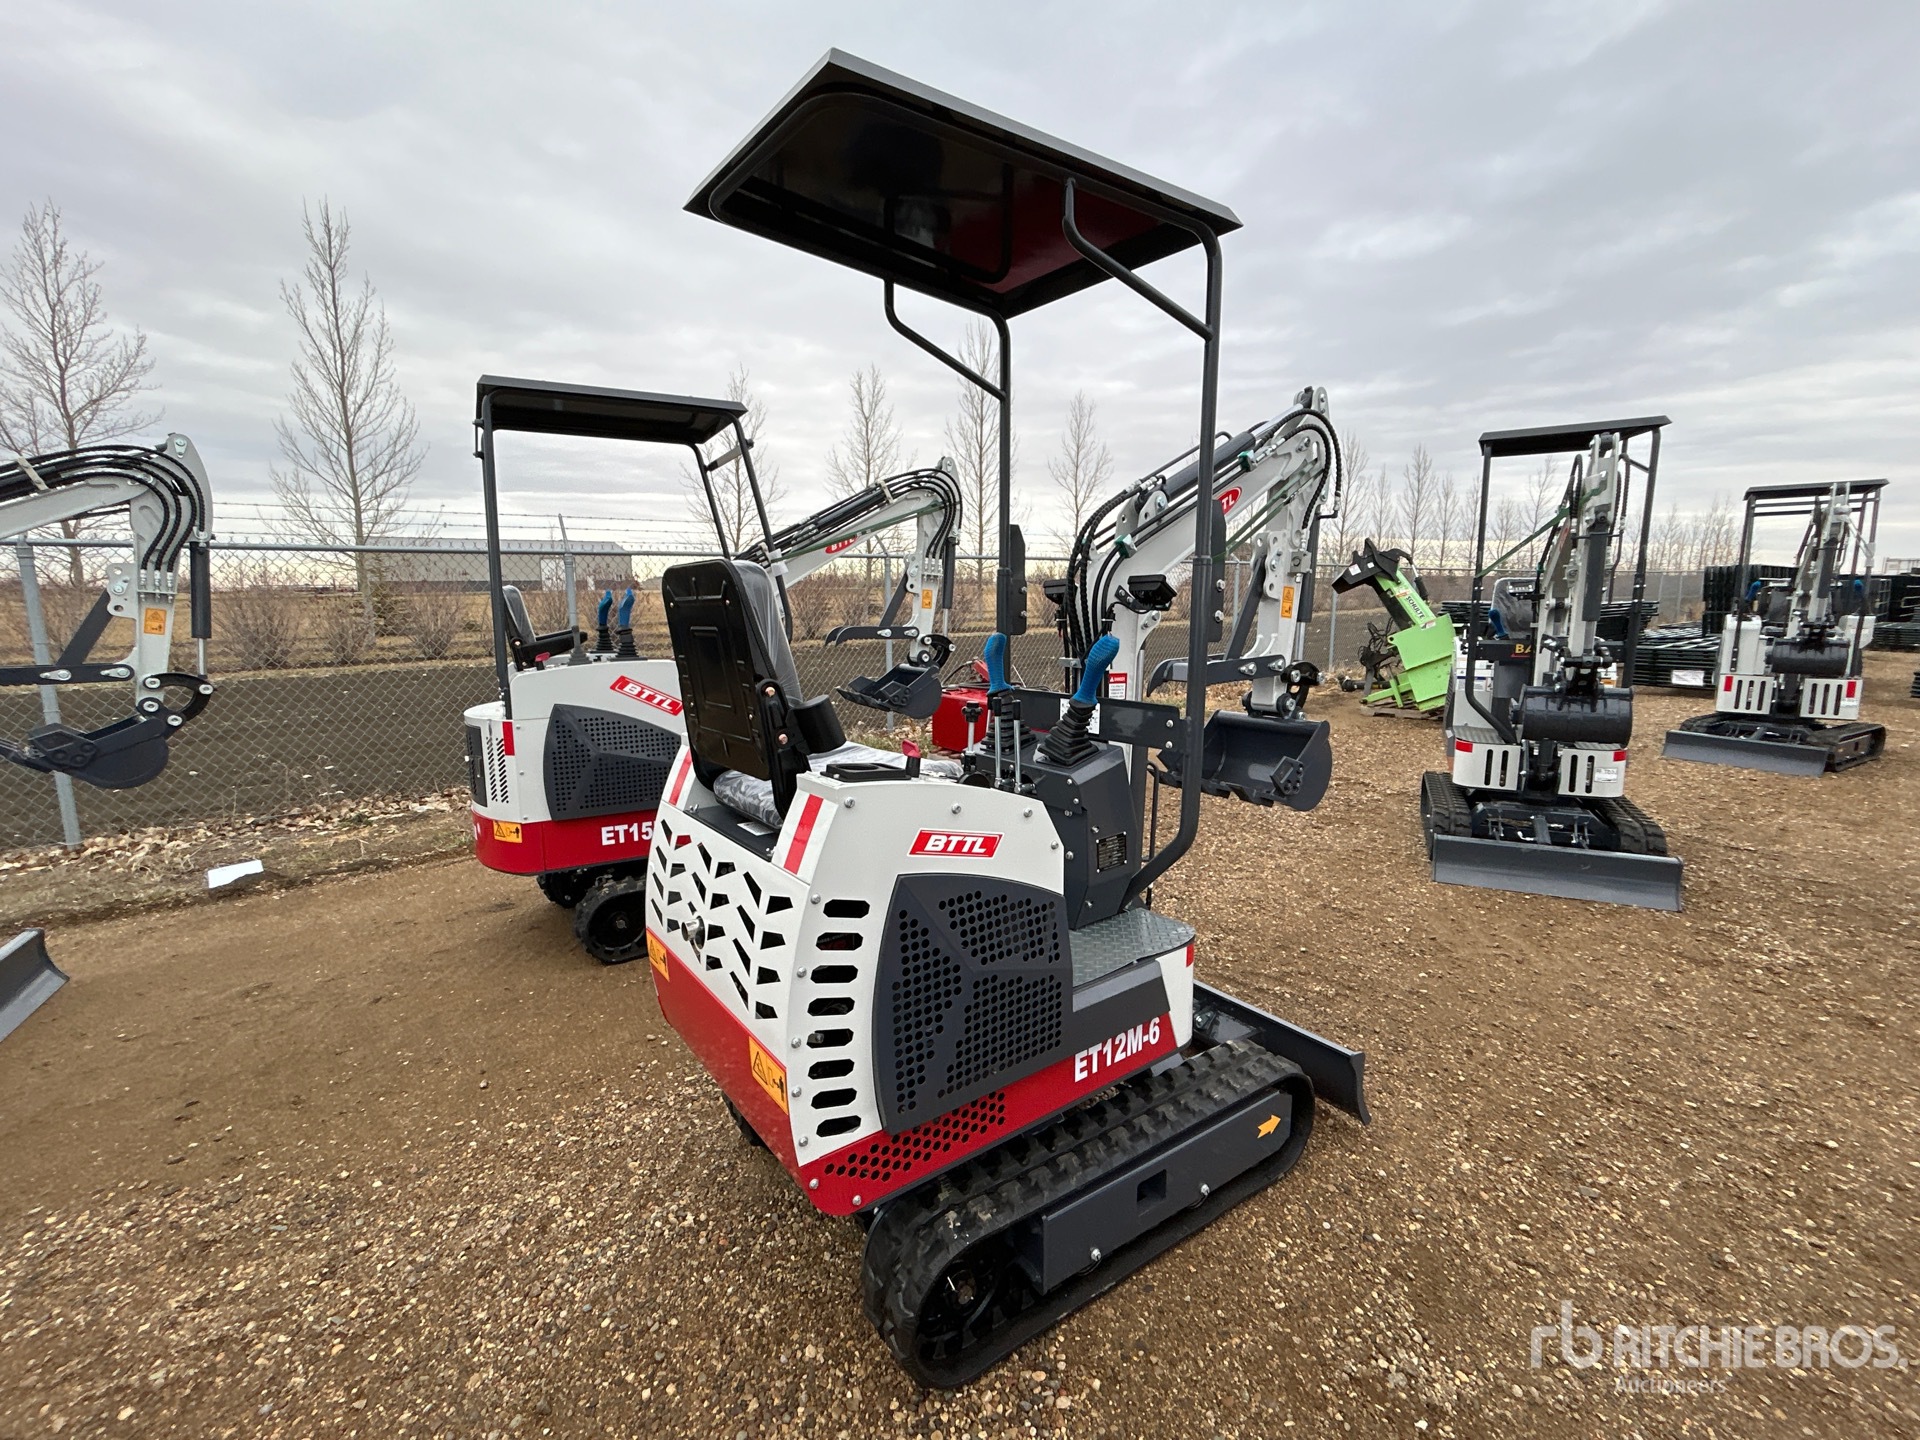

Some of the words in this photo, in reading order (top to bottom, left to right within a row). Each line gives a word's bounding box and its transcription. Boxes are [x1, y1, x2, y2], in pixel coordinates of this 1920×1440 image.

[1406, 596, 1425, 619] SCHULTE
[622, 682, 673, 711] BTTL
[923, 834, 987, 854] BTTL
[1074, 1016, 1160, 1083] ET12M-6
